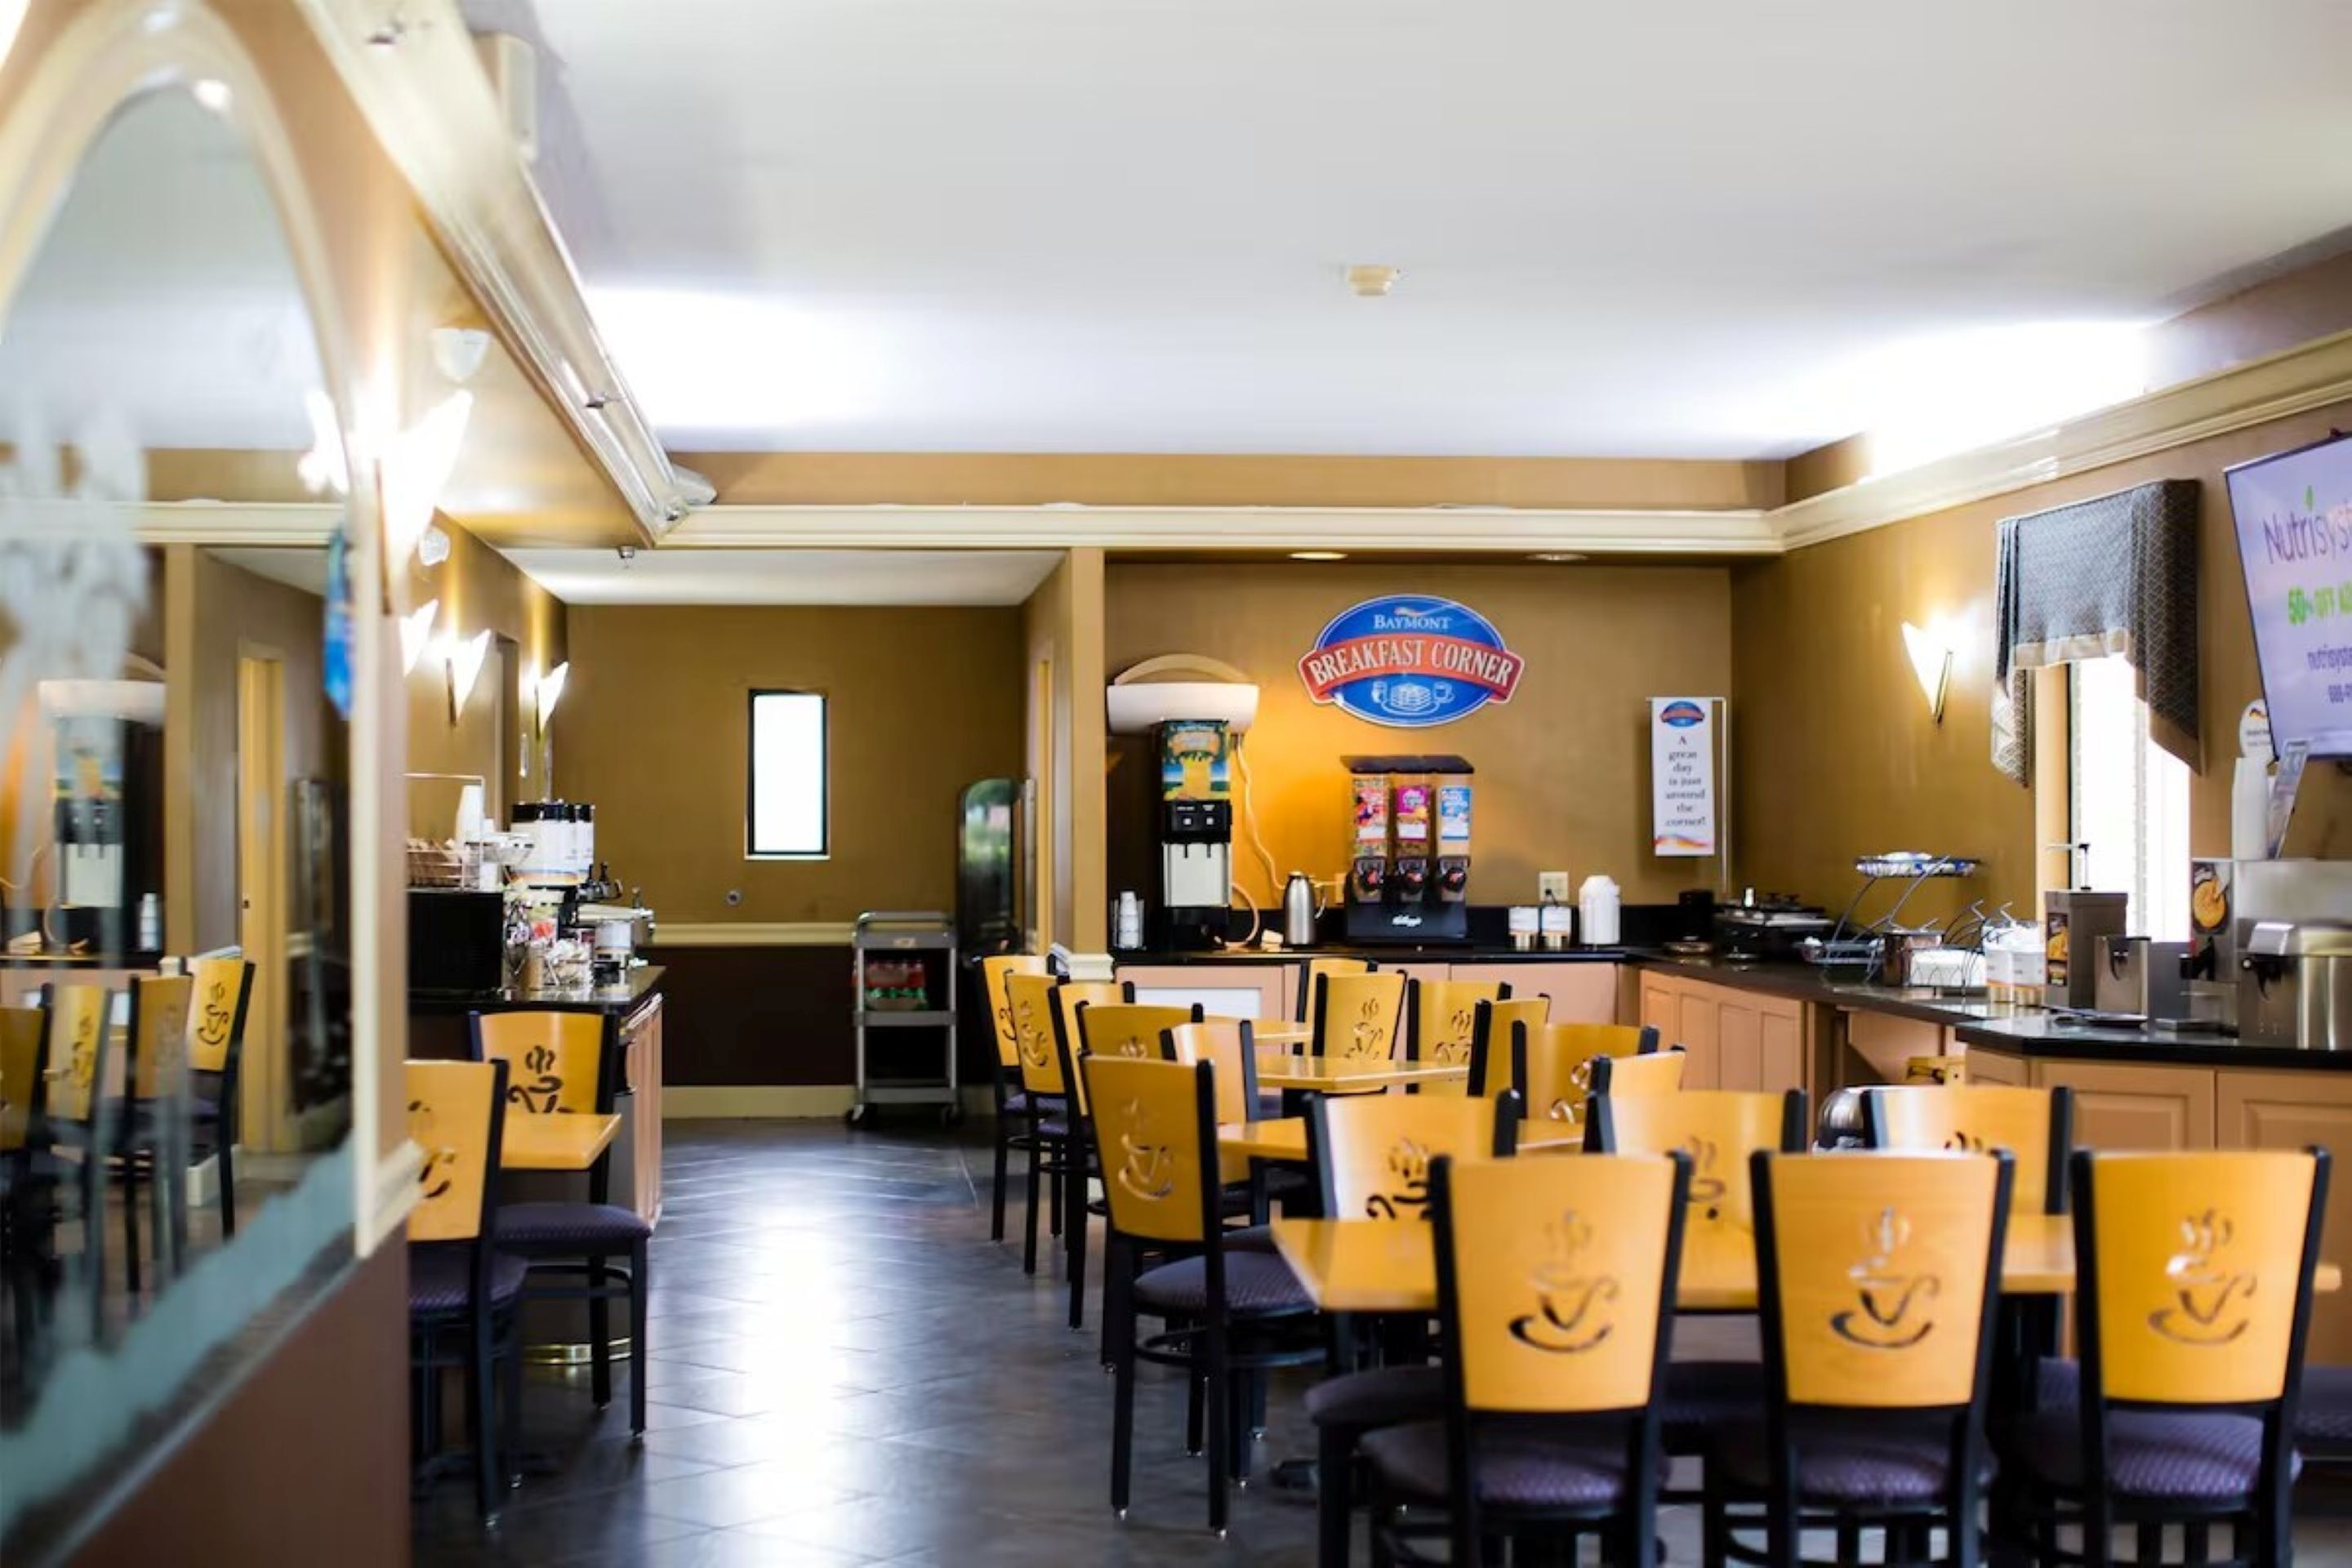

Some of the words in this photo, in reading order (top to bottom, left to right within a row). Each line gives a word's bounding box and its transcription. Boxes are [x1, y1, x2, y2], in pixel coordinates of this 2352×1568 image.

[2263, 508, 2352, 564] Nutrisys
[1373, 614, 1452, 630] BAYMONT
[1307, 639, 1424, 687] BREAKFAST
[1431, 641, 1515, 687] CORNER
[1679, 735, 1687, 745] A
[1668, 751, 1697, 762] great
[1673, 763, 1692, 774] day
[1668, 777, 1677, 786] is
[1681, 777, 1701, 786] just
[1666, 789, 1705, 800] around
[1677, 802, 1693, 813] the
